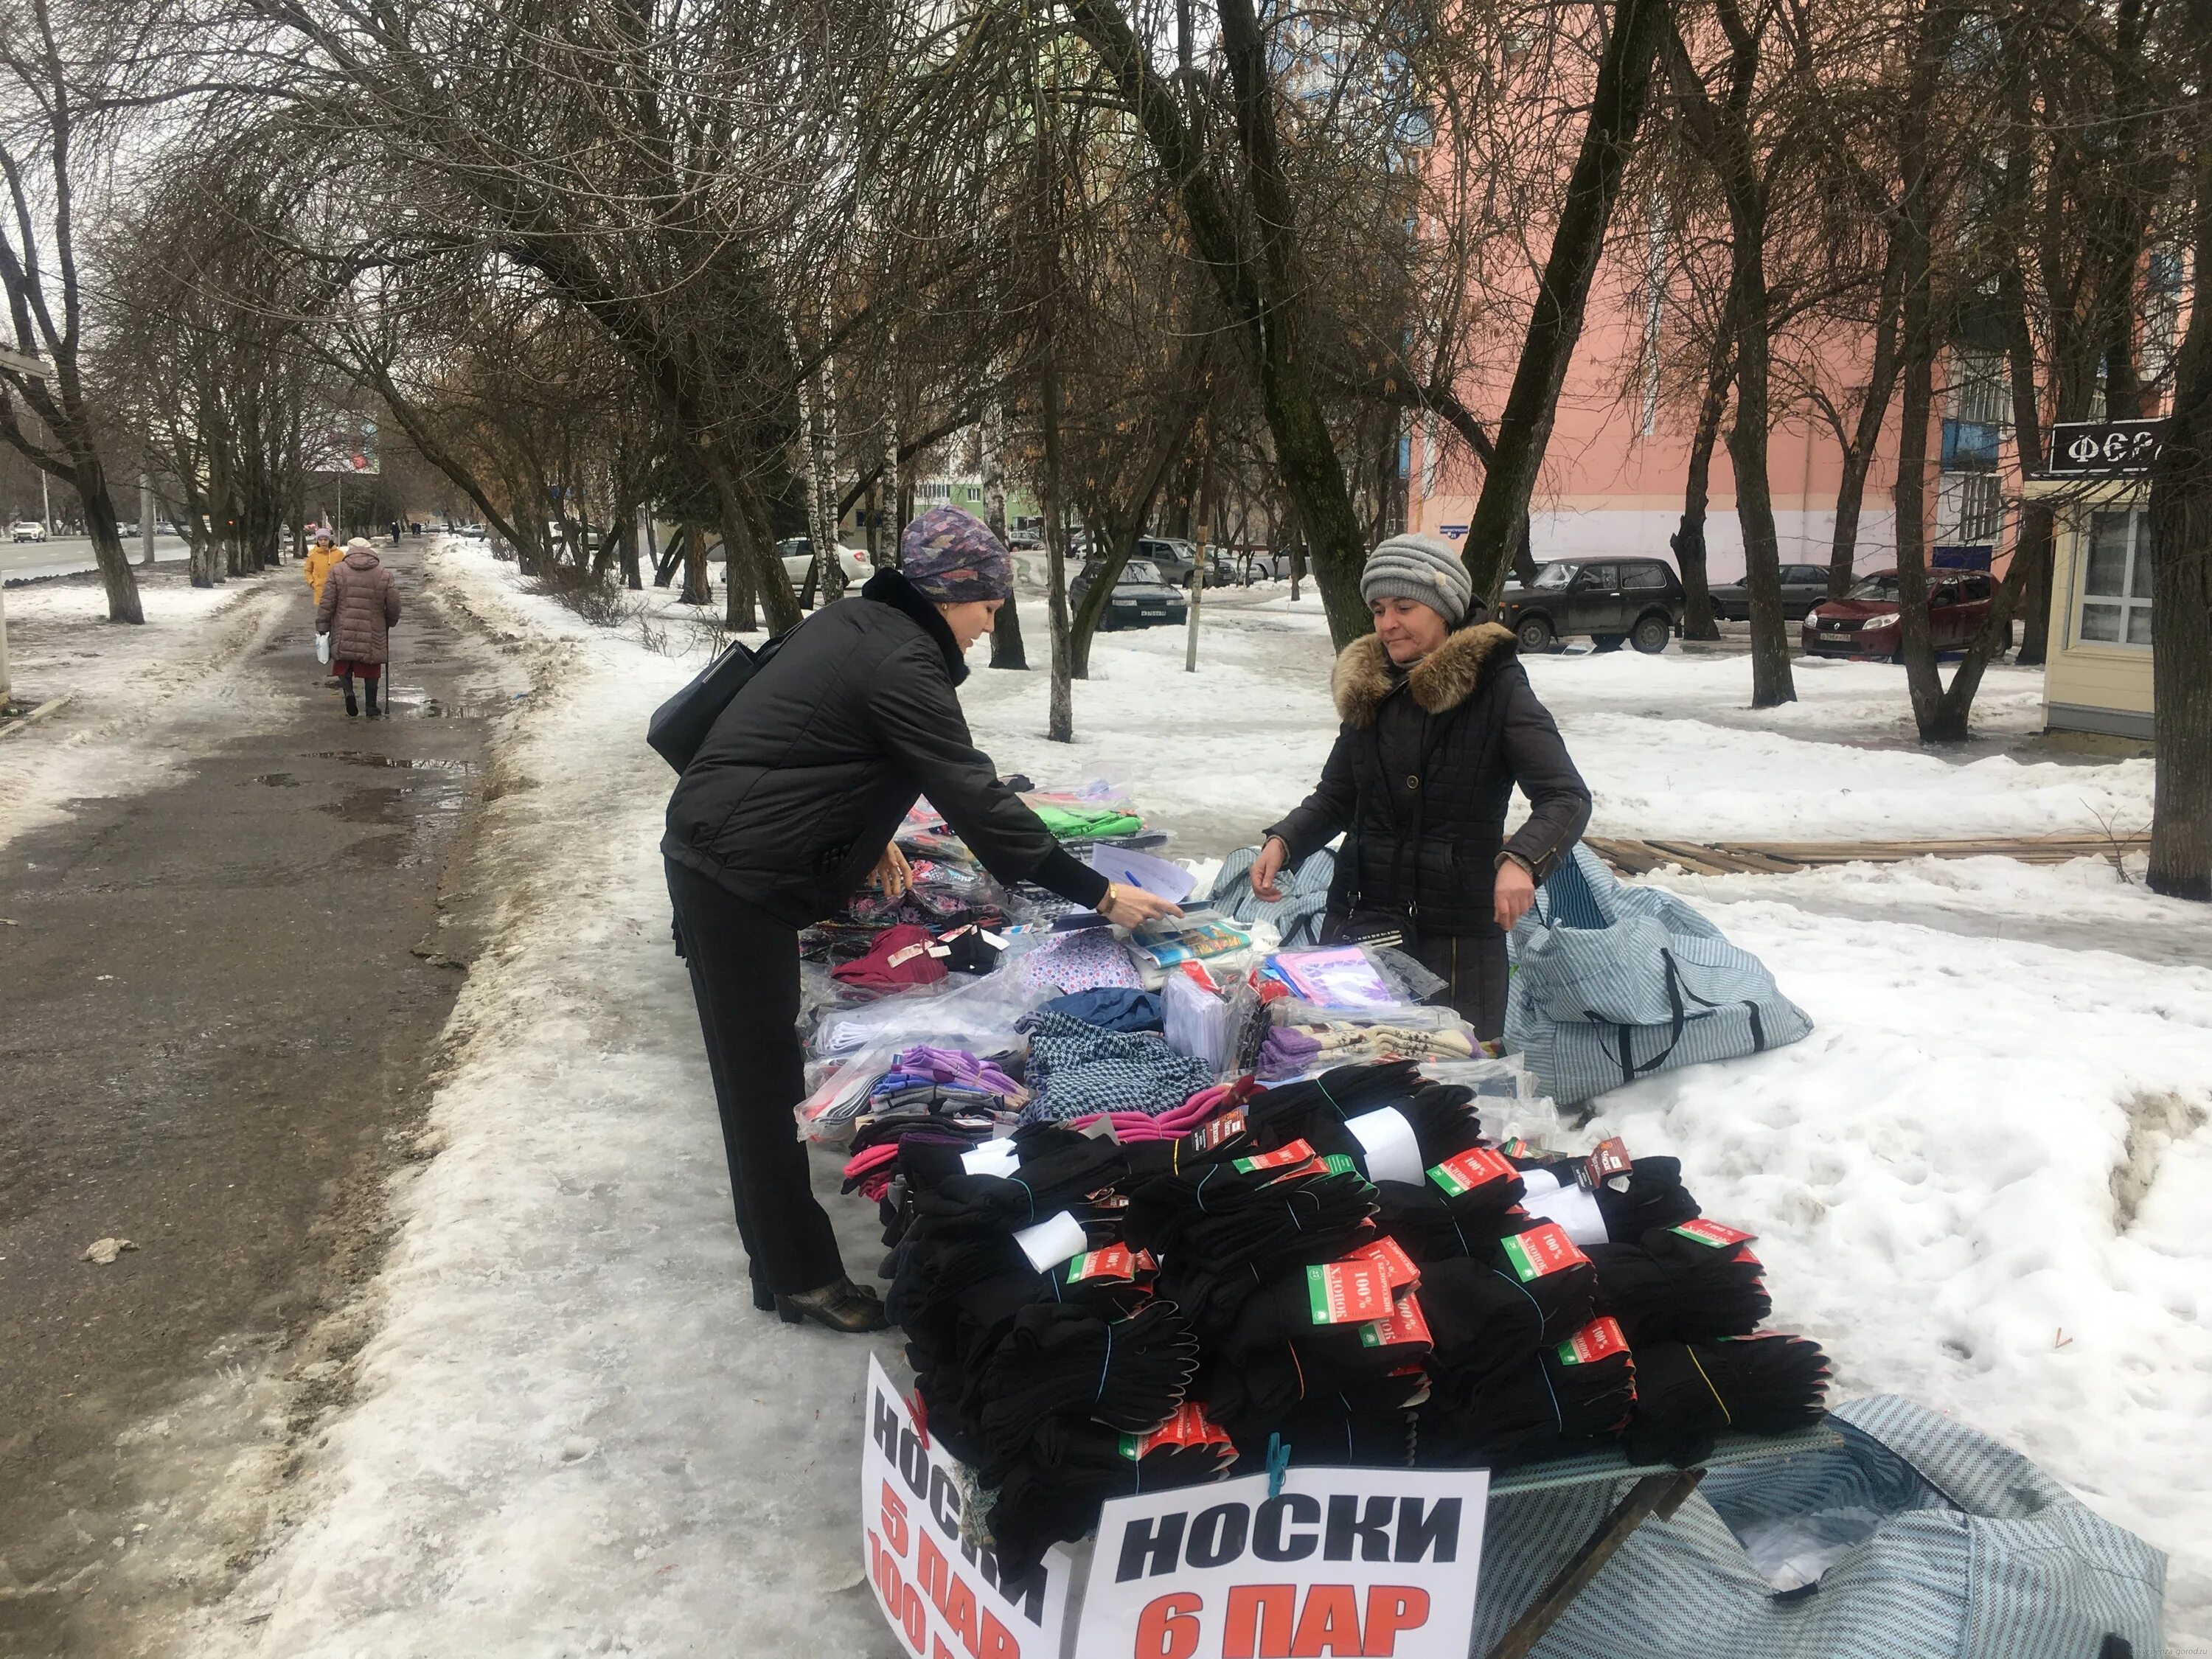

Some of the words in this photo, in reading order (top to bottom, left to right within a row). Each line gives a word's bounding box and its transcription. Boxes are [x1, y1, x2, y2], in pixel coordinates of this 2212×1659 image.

[1445, 1162, 1475, 1186] ХЛОПОК
[1464, 1156, 1488, 1176] 100%
[1543, 1233, 1566, 1260] 100%
[1703, 1222, 1737, 1237] 100%
[1105, 1252, 1121, 1268] 100%
[1368, 1248, 1399, 1277] 10%
[1523, 1236, 1549, 1271] ХЛОПОК
[1330, 1266, 1348, 1319] ХЛОПОК
[1354, 1272, 1374, 1309] 100%
[1377, 1262, 1393, 1314] БЕЛОРУССКИЙ
[1397, 1297, 1419, 1331] 00%
[1592, 1326, 1610, 1350] 100%
[873, 1385, 1048, 1628] НОСИ
[1115, 1493, 1463, 1583] НОСКИ
[880, 1477, 908, 1559] 5
[917, 1525, 1021, 1659] ПАР
[868, 1527, 927, 1655] 100
[1134, 1592, 1203, 1659] 6
[1221, 1584, 1431, 1658] ПАР
